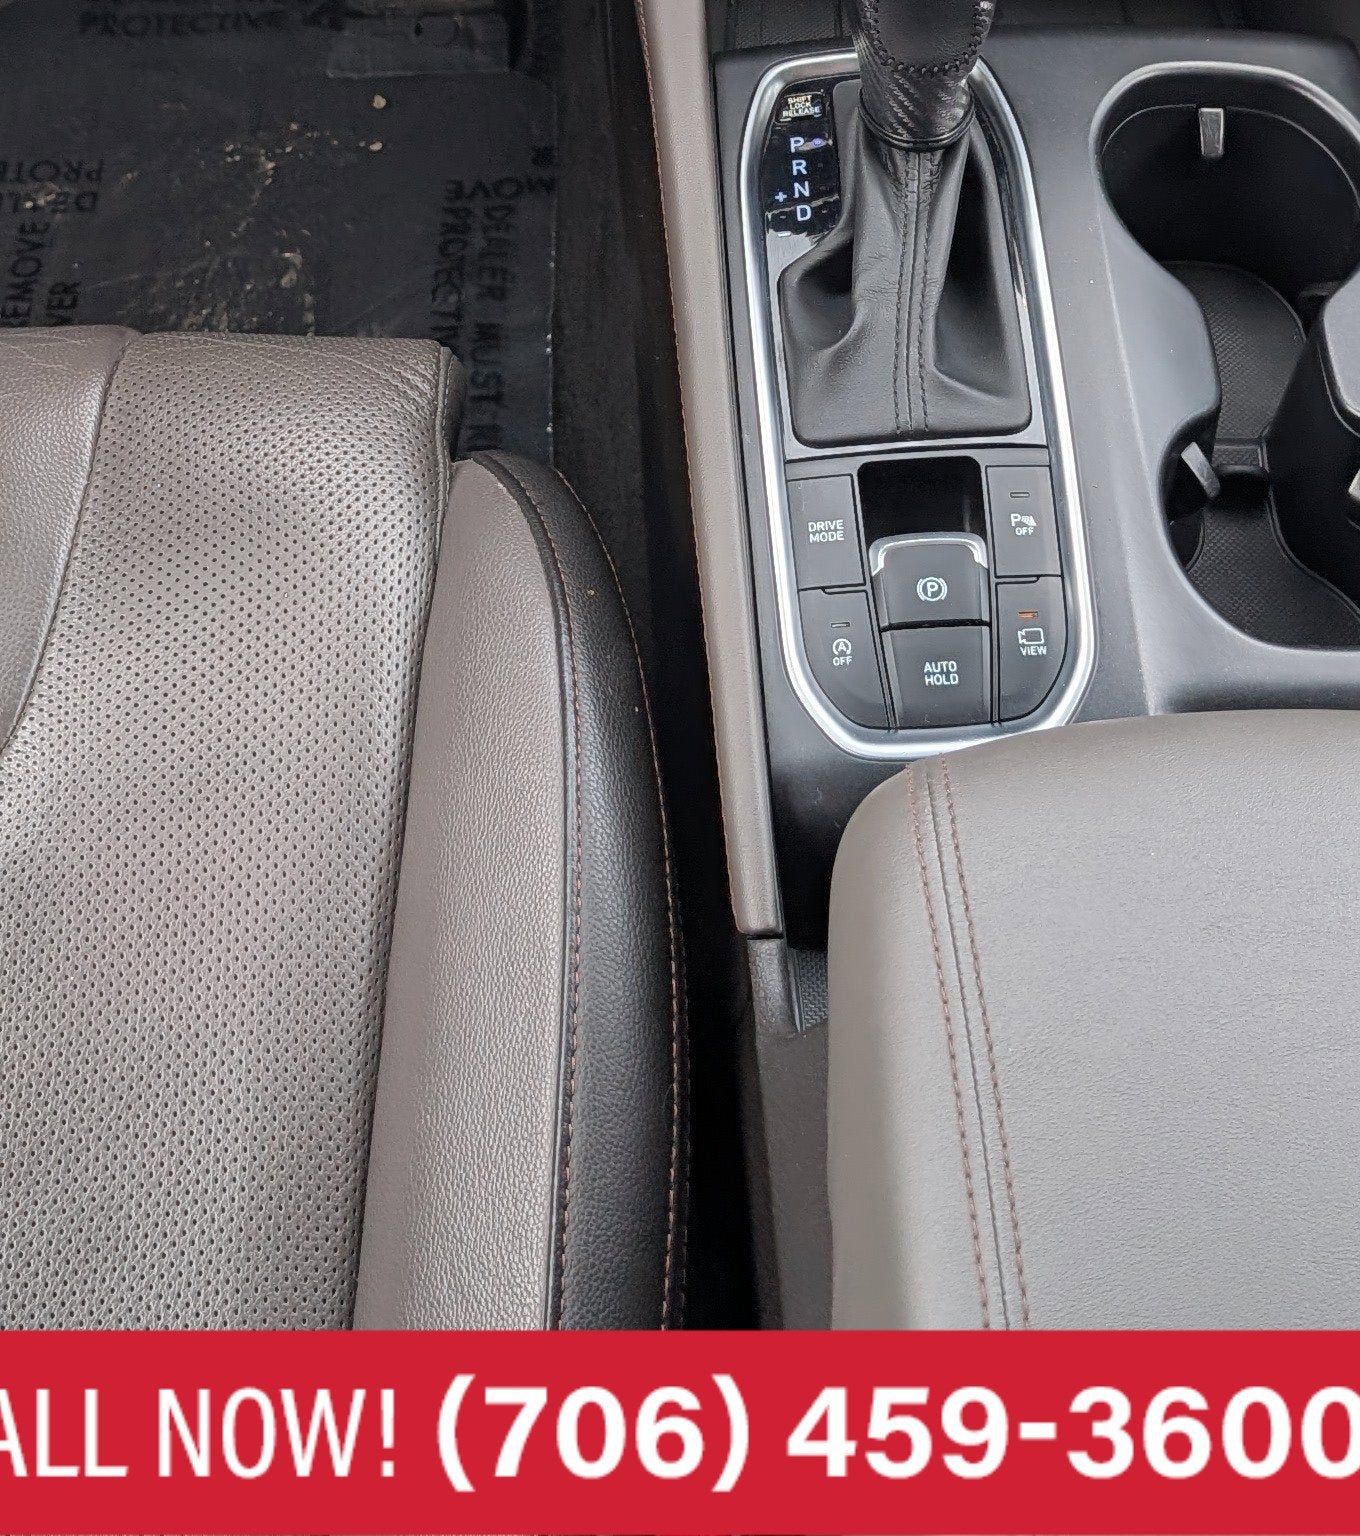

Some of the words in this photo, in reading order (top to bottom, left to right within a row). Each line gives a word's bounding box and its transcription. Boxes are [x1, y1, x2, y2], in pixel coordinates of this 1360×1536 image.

[787, 95, 812, 104] SHIFT
[782, 106, 821, 118] RELEASE
[789, 102, 812, 110] LOCK
[789, 136, 805, 154] P
[792, 159, 807, 176] R
[793, 180, 810, 199] N
[796, 205, 812, 222] D
[808, 520, 844, 532] DRIVE
[1015, 527, 1034, 536] OFF
[809, 531, 844, 542] MODE
[1020, 646, 1047, 656] VIEW
[833, 656, 852, 666] OFF
[924, 661, 957, 673] AUTO
[925, 674, 959, 686] HOLD
